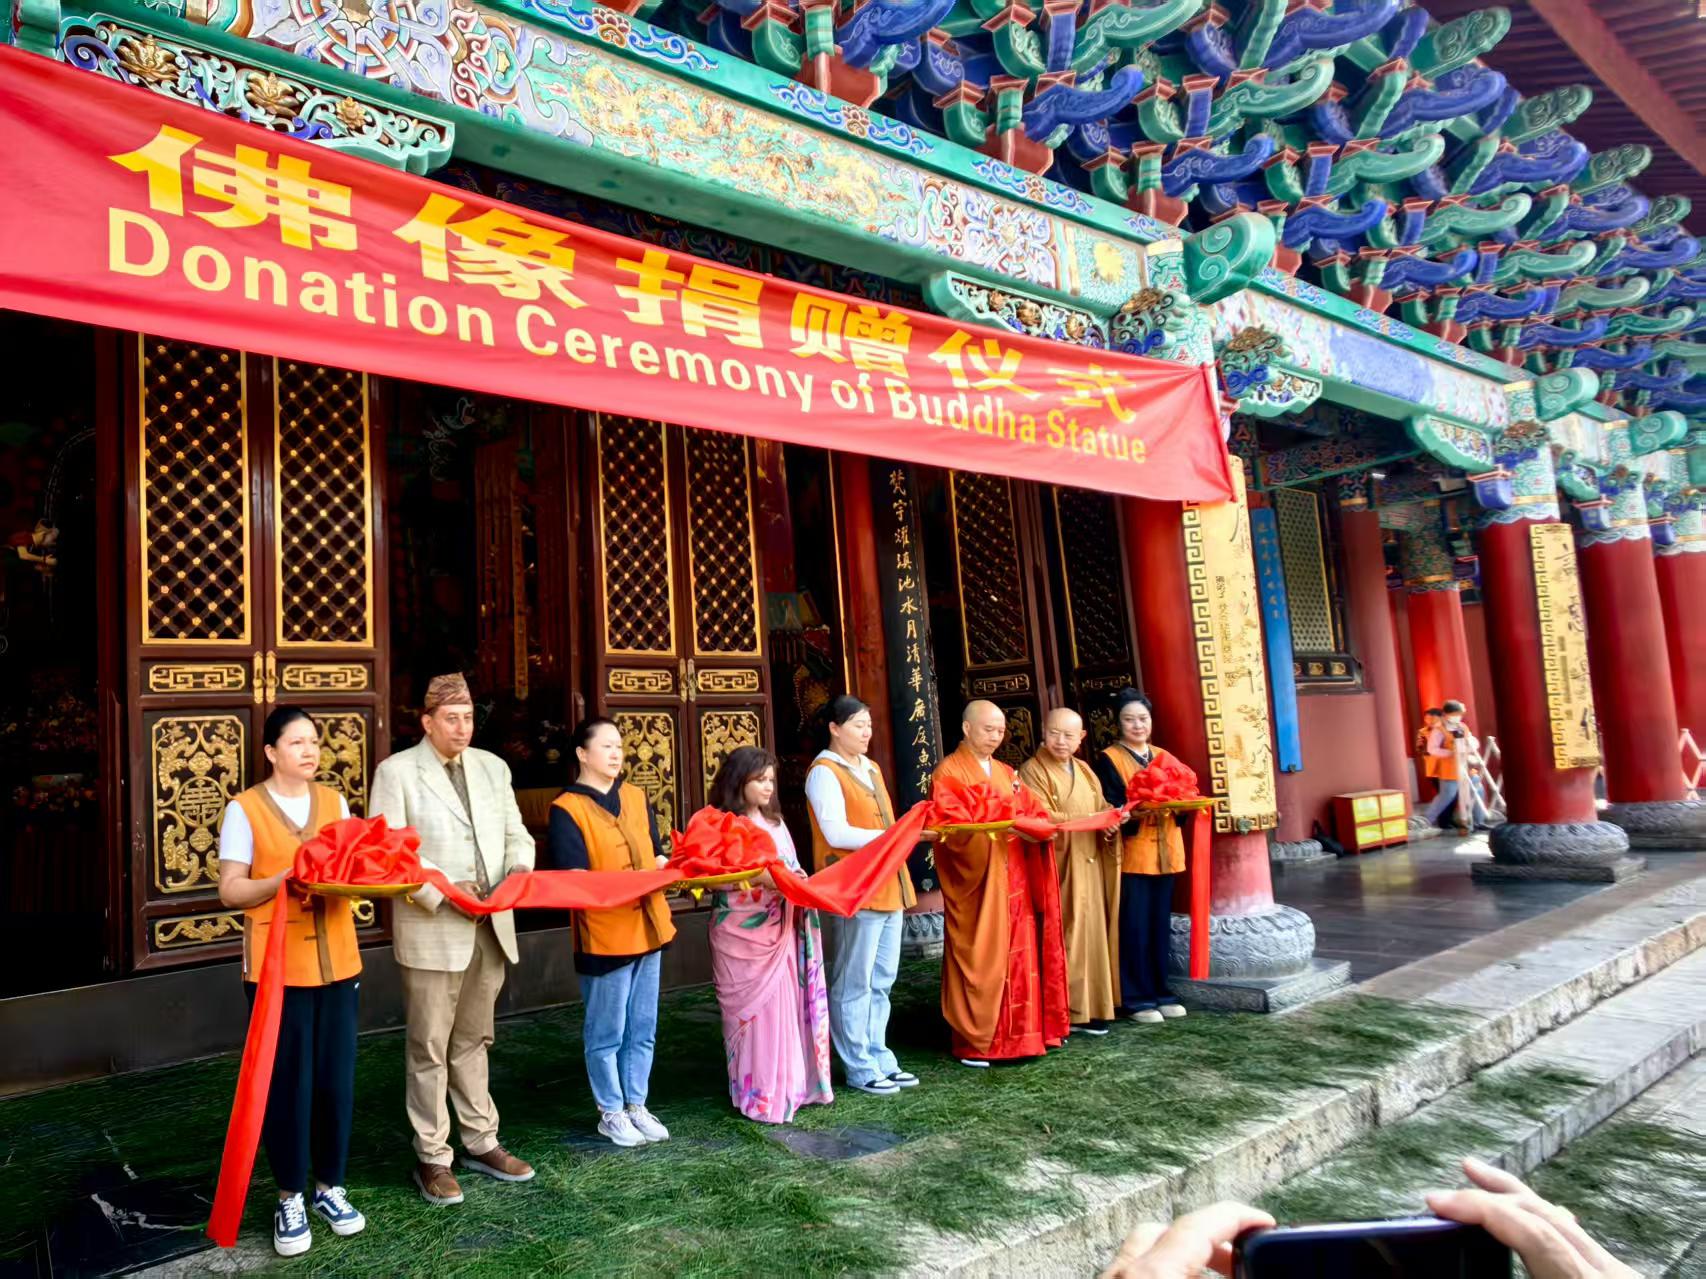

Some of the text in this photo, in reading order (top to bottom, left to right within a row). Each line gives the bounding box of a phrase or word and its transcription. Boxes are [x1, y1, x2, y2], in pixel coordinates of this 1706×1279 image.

[108, 124, 1140, 425] 佛像捐赠仪式
[108, 206, 1148, 464] Donation Ceremony of Buddha Statue
